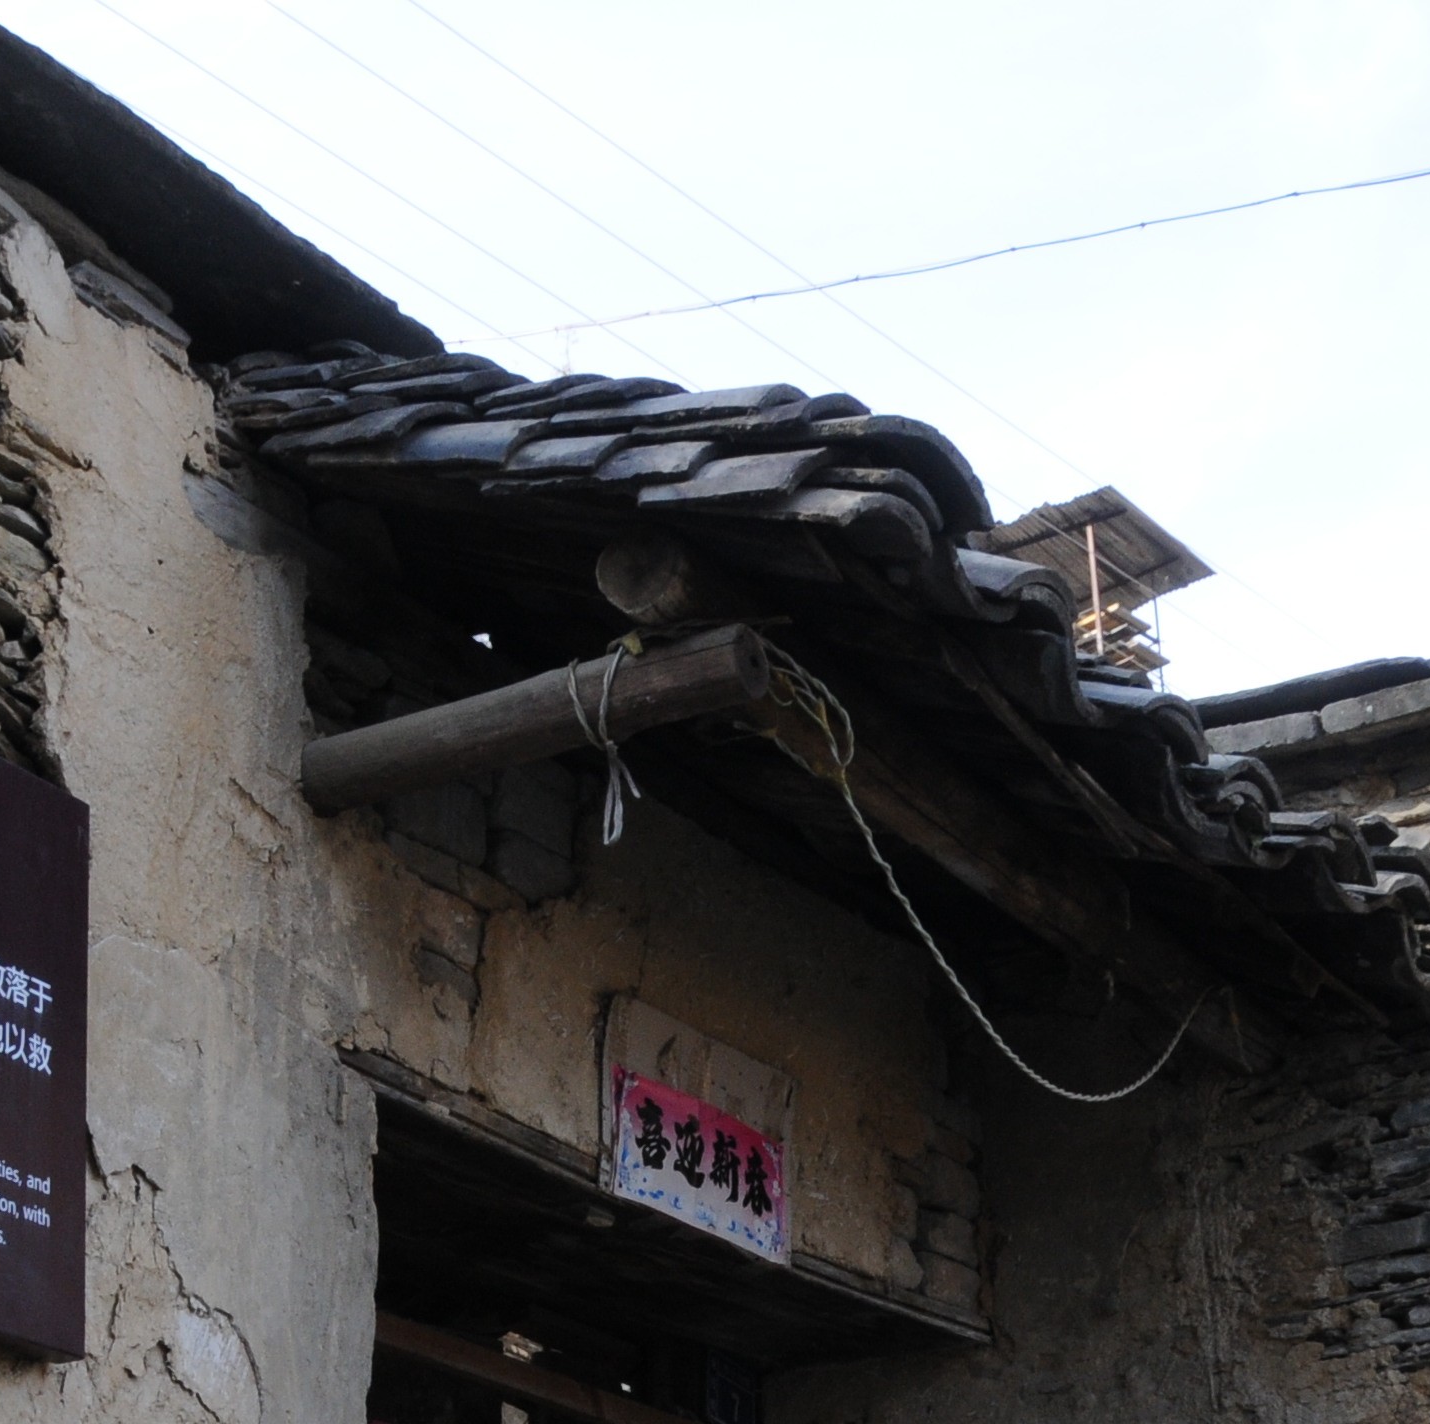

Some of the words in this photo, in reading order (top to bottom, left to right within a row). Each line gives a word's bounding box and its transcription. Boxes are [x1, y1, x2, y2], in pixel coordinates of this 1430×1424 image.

[635, 1097, 773, 1217] 喜迎新春
[26, 1174, 51, 1195] and
[22, 1204, 51, 1229] with
